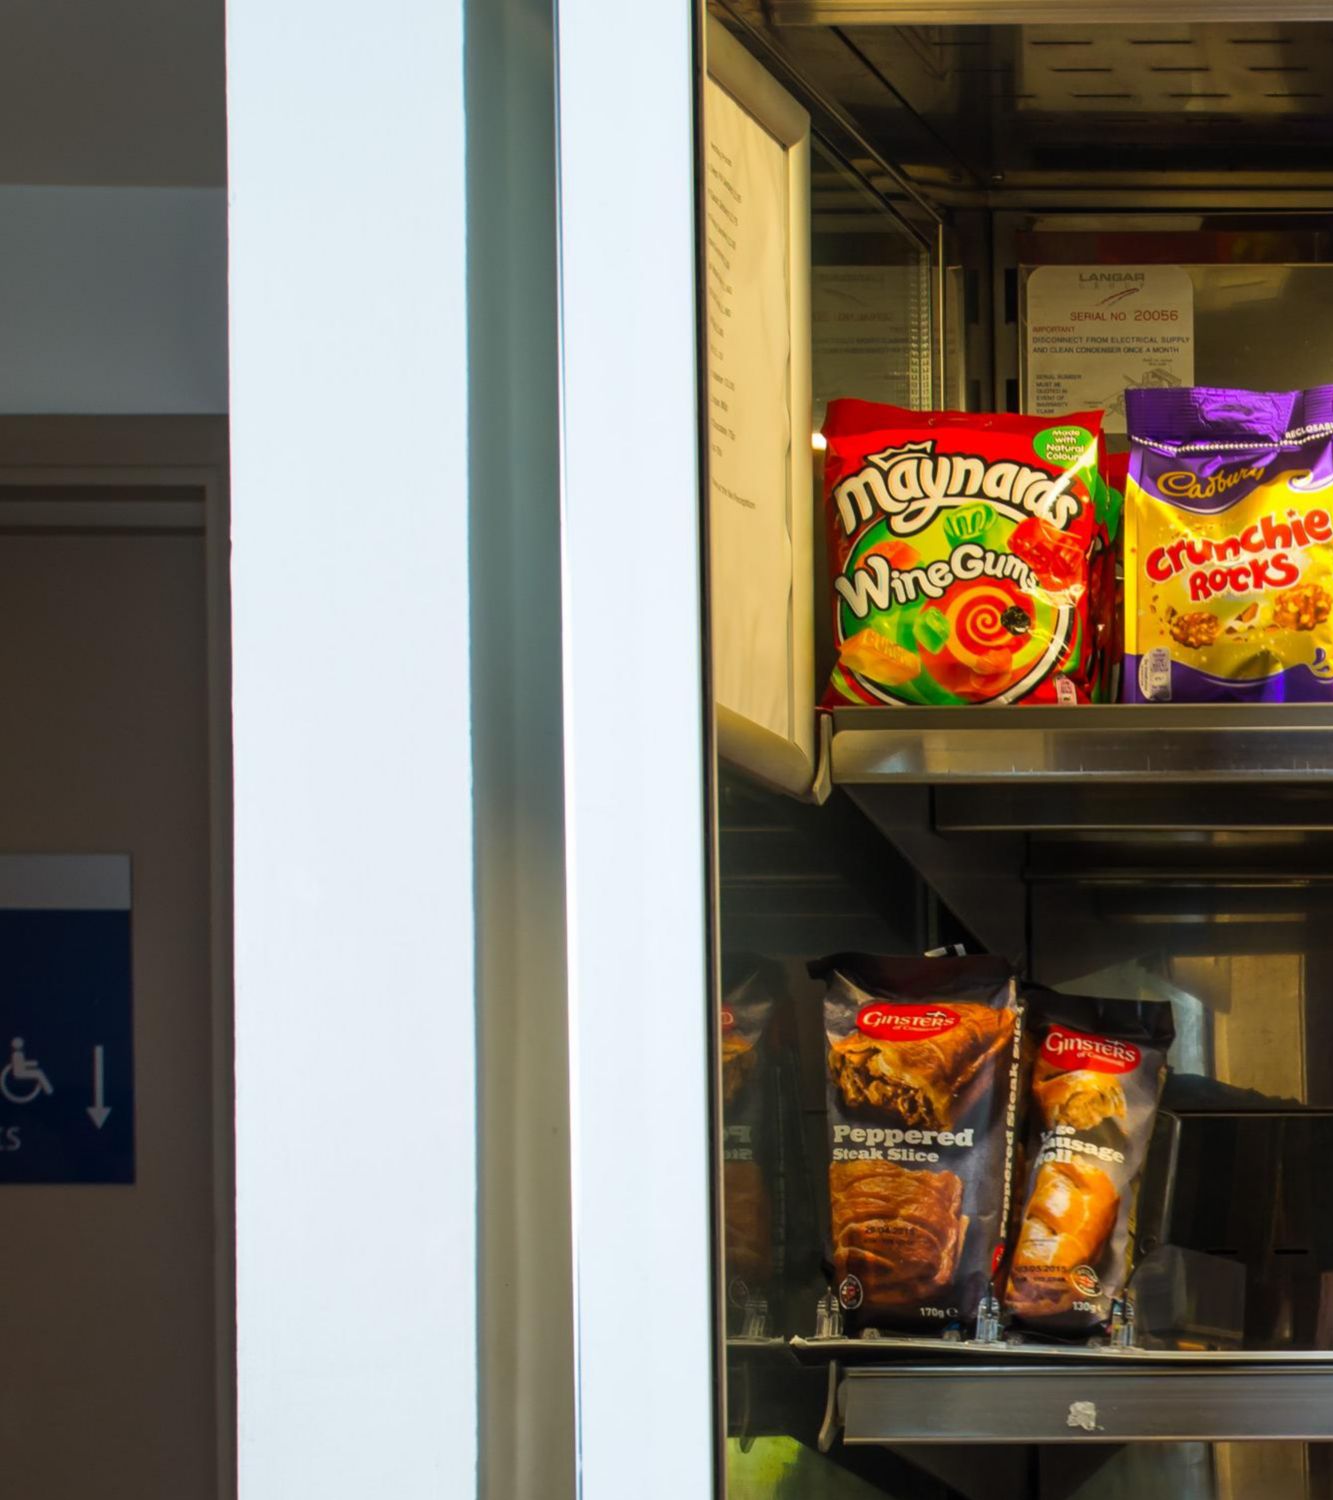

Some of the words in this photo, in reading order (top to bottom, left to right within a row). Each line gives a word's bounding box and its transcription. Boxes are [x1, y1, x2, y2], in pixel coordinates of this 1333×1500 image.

[1078, 272, 1146, 282] LANGAR
[1070, 311, 1107, 322] SERIAL
[1134, 309, 1179, 322] 20056
[1032, 326, 1076, 334] IMPORTANT
[1032, 336, 1083, 344] DISCONNECT
[1085, 336, 1109, 344] FROM
[1110, 336, 1158, 344] ELECTRICAL
[1160, 336, 1191, 344] SUPPLY
[1049, 346, 1074, 354] CLEAN
[1152, 346, 1179, 354] MONTH
[1046, 443, 1084, 453] Natural
[1156, 466, 1266, 499] Cadbury
[833, 456, 1080, 537] Maynards
[1006, 1062, 1019, 1127] Steak
[832, 1124, 975, 1149] Peppered
[832, 1147, 884, 1163] Steak
[886, 1147, 939, 1164] Slice
[919, 1306, 945, 1319] 170g
